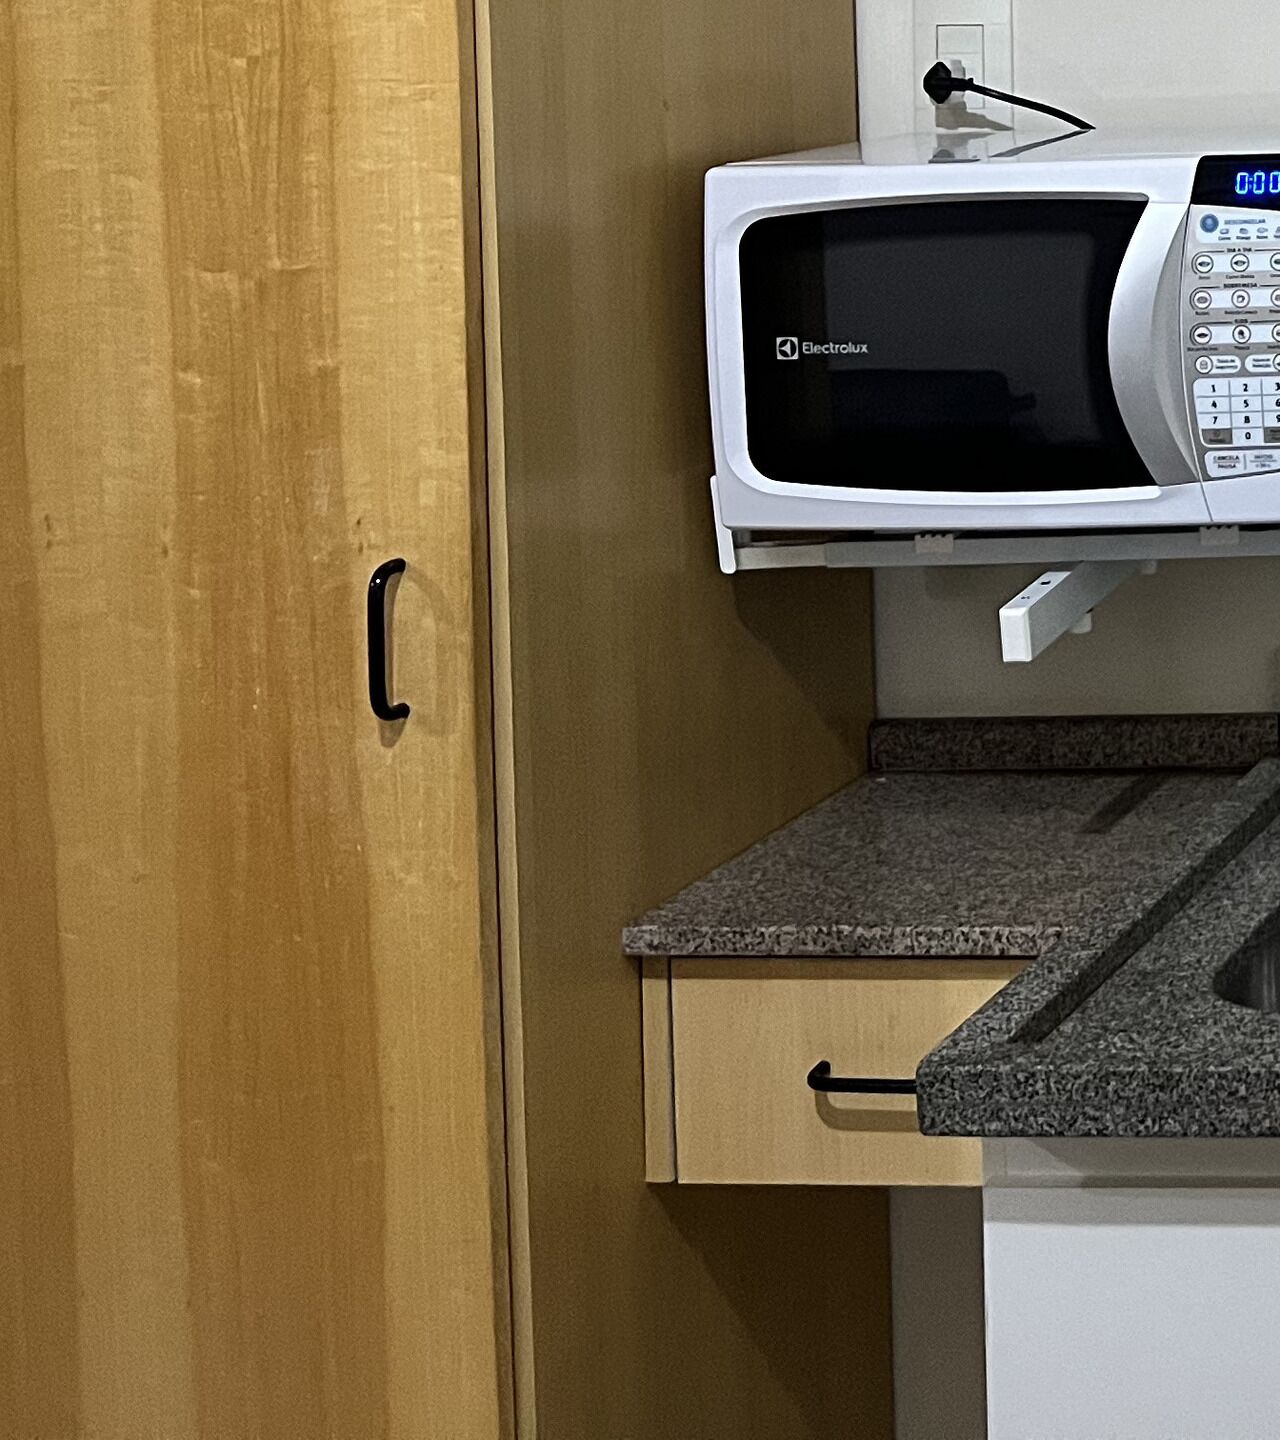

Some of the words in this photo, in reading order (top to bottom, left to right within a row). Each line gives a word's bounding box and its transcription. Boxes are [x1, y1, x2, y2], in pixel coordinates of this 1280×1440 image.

[802, 341, 868, 354] Electrolux
[1211, 384, 1216, 393] 1
[1243, 383, 1248, 392] 2
[1275, 382, 1280, 391] 3
[1211, 400, 1217, 409] 4
[1244, 399, 1249, 408] 5
[1275, 398, 1280, 407] 6
[1213, 416, 1218, 424] 7
[1244, 415, 1250, 424] 8
[1245, 431, 1251, 440] 0
